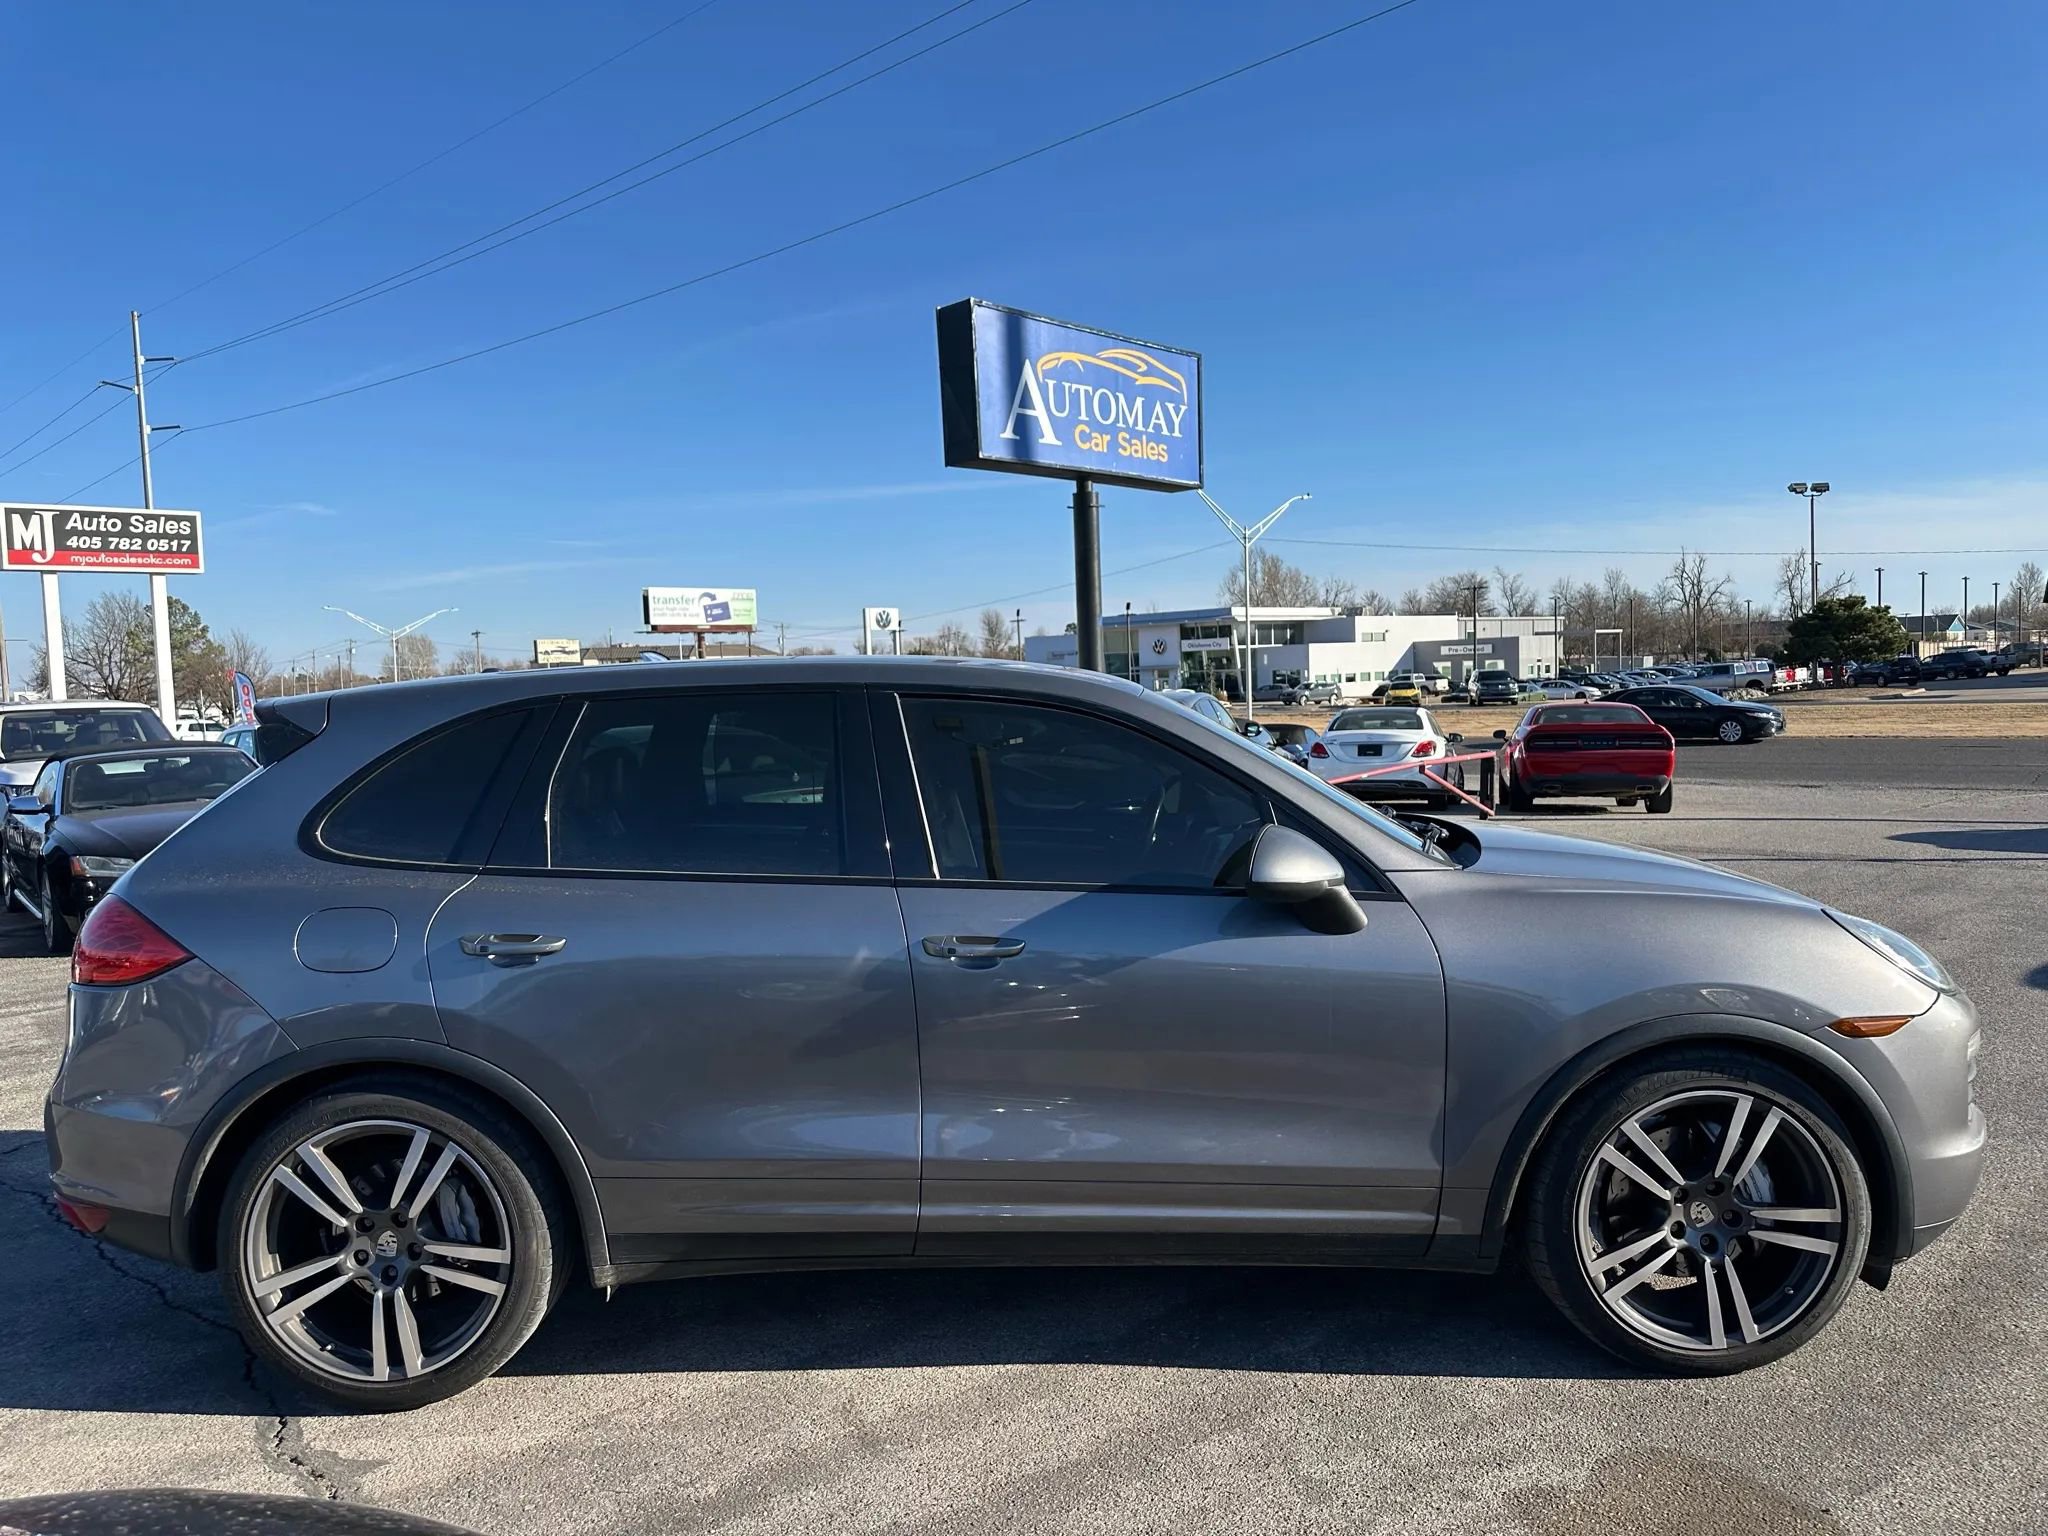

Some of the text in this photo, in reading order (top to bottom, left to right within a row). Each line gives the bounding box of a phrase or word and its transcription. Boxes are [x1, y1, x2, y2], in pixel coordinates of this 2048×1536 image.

[999, 359, 1188, 446] AUTOMAY
[1074, 424, 1168, 463] Car Sales
[65, 512, 191, 535] Auto Sales
[11, 510, 60, 564] MJ
[66, 536, 192, 552] 405 782 0517
[70, 552, 192, 566] mjautosalesokc.com
[652, 594, 695, 605] transfer
